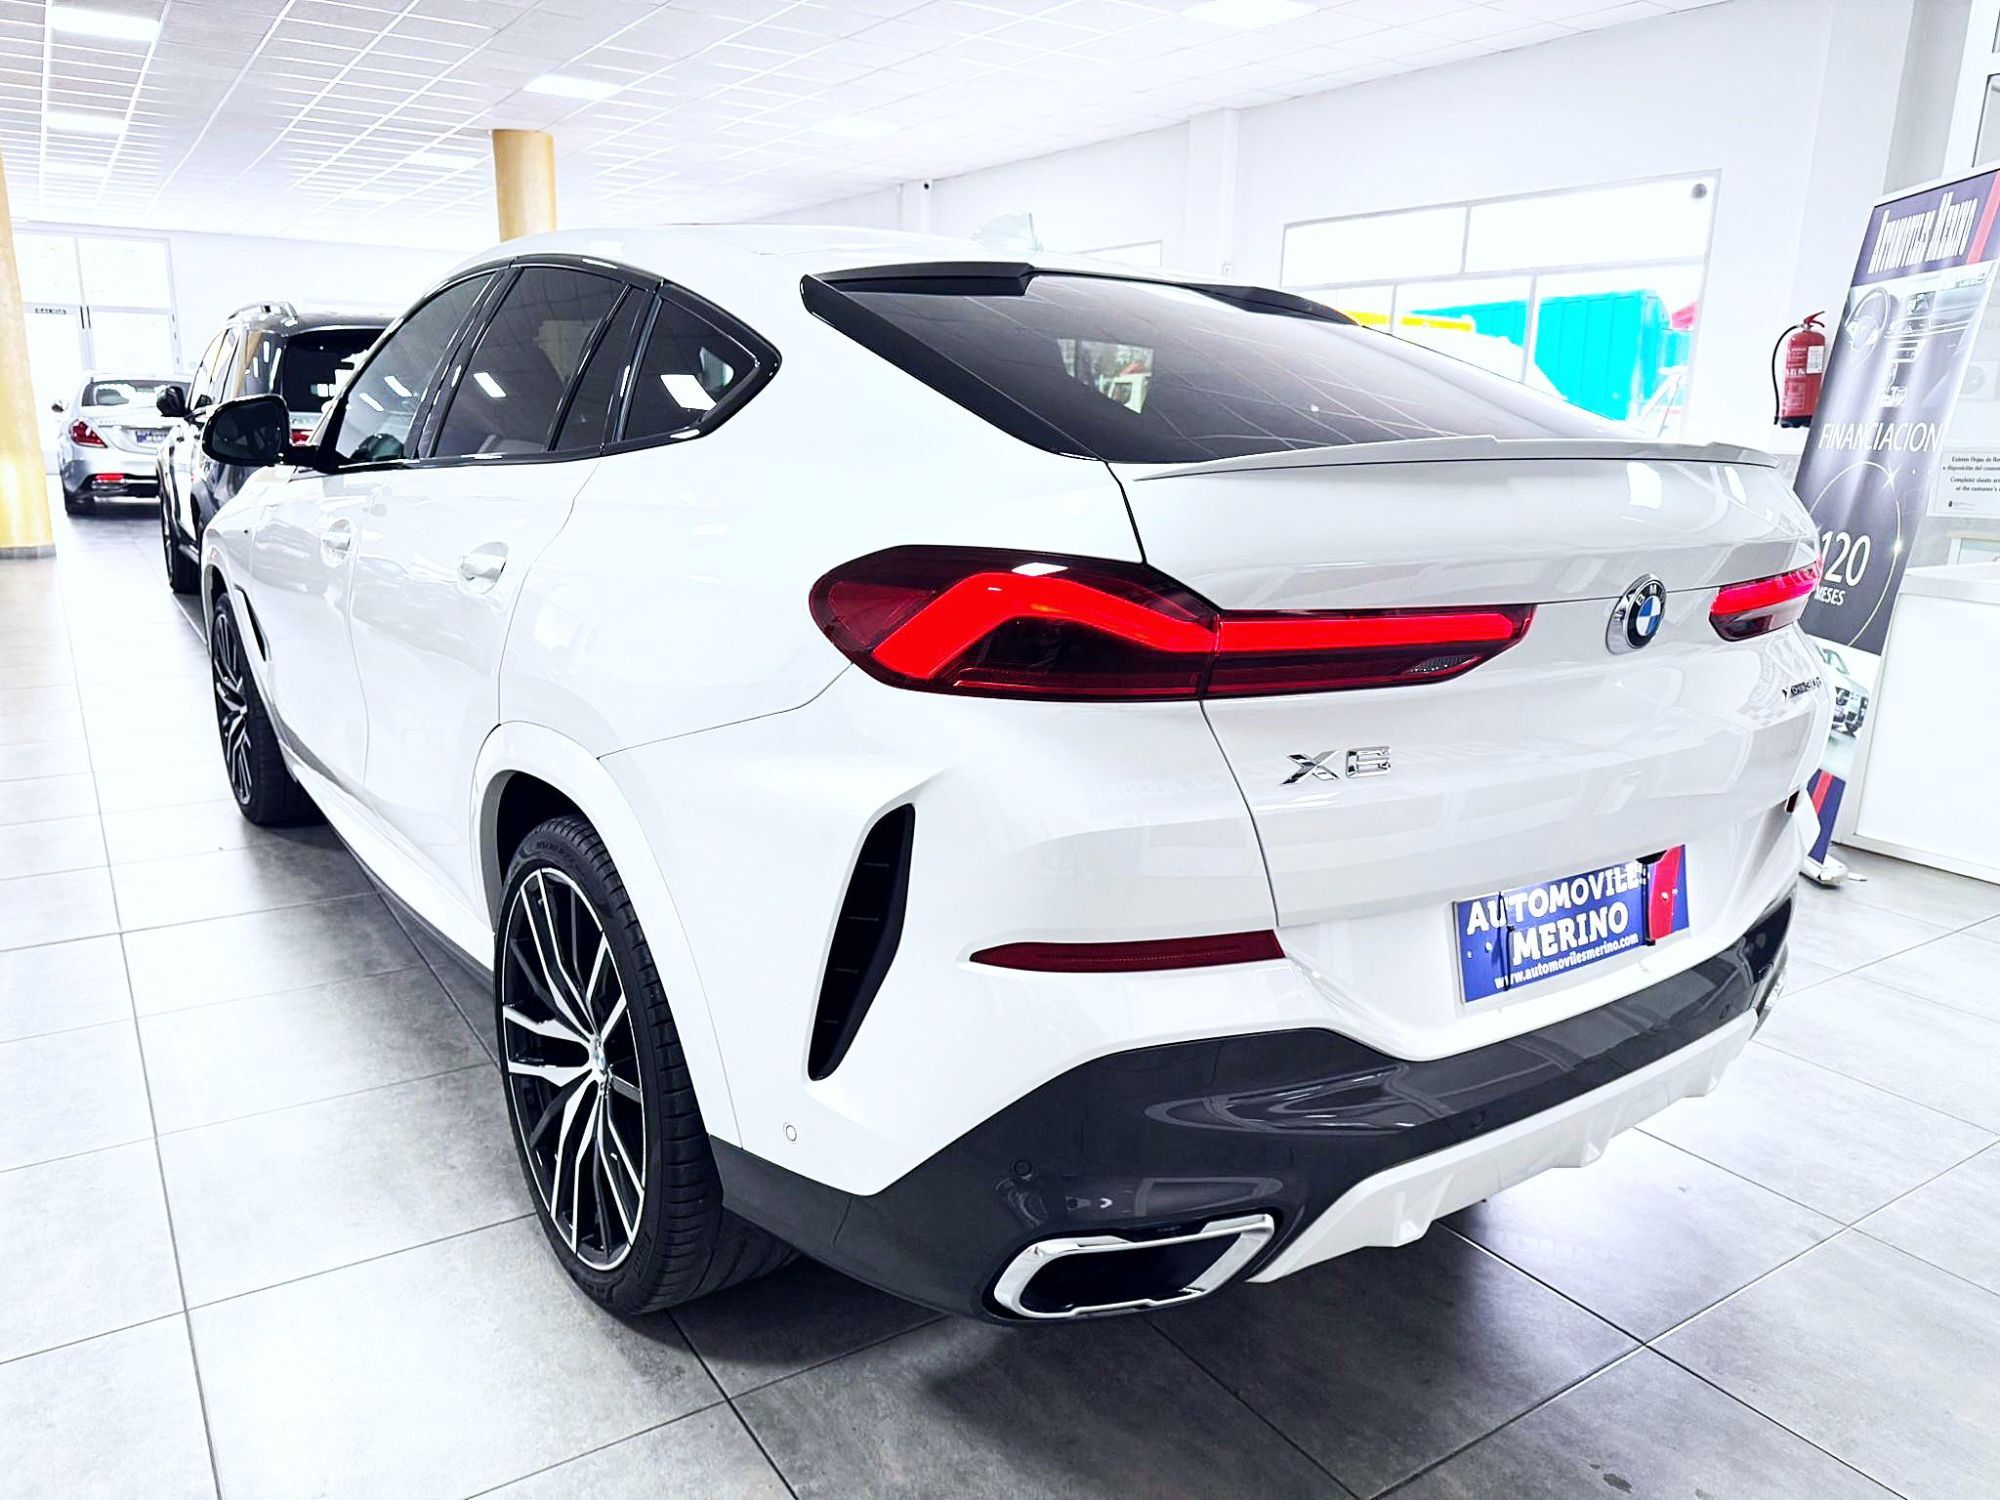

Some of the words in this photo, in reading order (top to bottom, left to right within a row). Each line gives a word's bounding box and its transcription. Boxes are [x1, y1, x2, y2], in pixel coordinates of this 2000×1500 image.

[1818, 421, 1944, 453] FINANCIACION
[1820, 530, 1871, 587] 120
[1279, 746, 1392, 786] X6
[1513, 902, 1628, 966] MERINO
